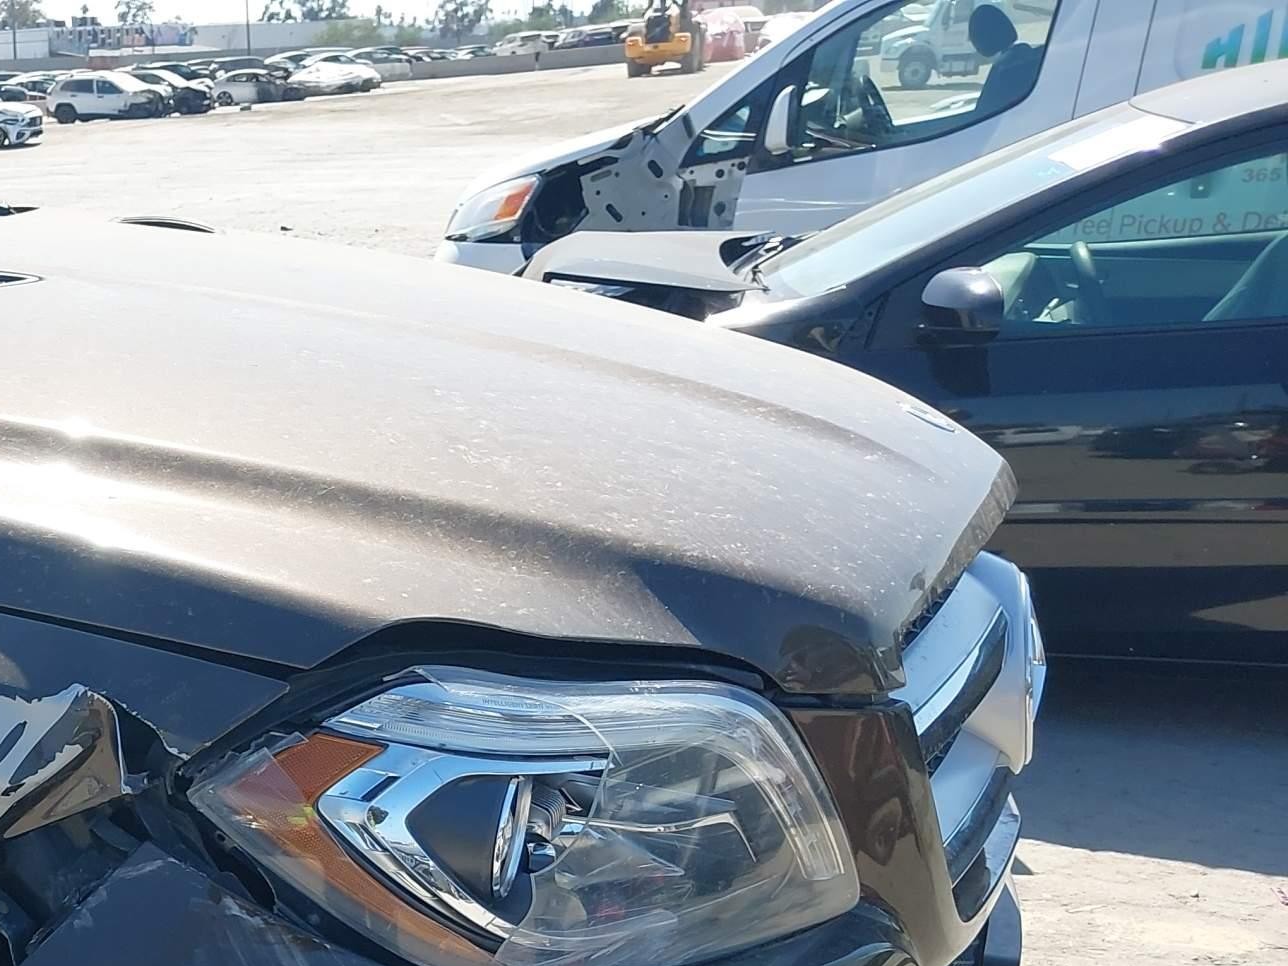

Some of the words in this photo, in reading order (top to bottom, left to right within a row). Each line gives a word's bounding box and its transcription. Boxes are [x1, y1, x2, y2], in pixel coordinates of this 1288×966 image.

[1240, 168, 1281, 183] 365
[1119, 212, 1203, 236] Pickup
[1212, 212, 1232, 233] &
